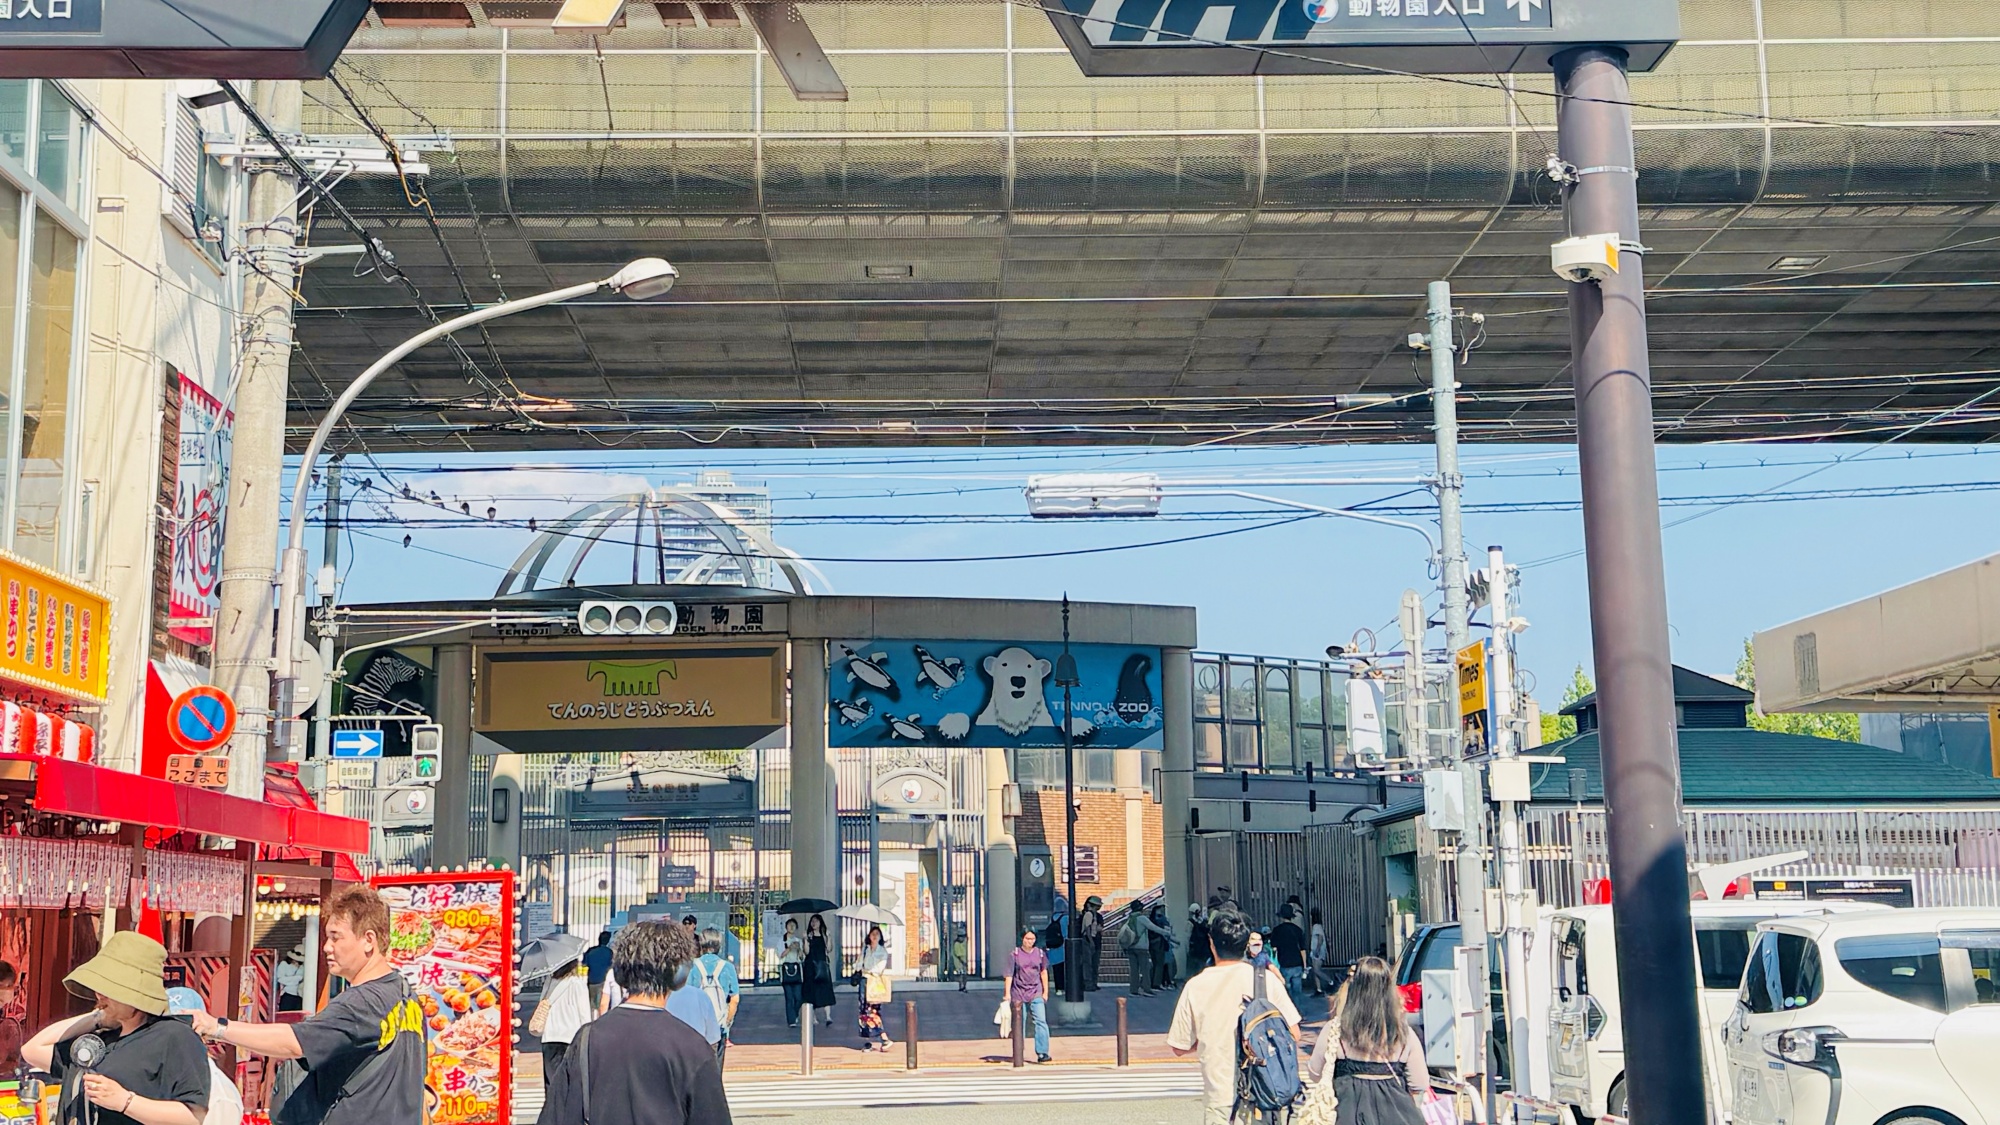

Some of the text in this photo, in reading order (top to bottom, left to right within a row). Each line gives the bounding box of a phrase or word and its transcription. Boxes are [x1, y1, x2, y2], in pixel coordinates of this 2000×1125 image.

[1348, 0, 1485, 17] 動物園入口
[497, 627, 549, 636] TENNOJI
[731, 624, 763, 632] PARK
[548, 699, 715, 719] てんのうじどうぶつえん
[1052, 701, 1149, 713] TNNOJI ZOO
[168, 769, 228, 784] ここまで
[410, 884, 500, 908] お好み焼き
[404, 962, 460, 986] こ焼き
[444, 1067, 496, 1094] 串かつ
